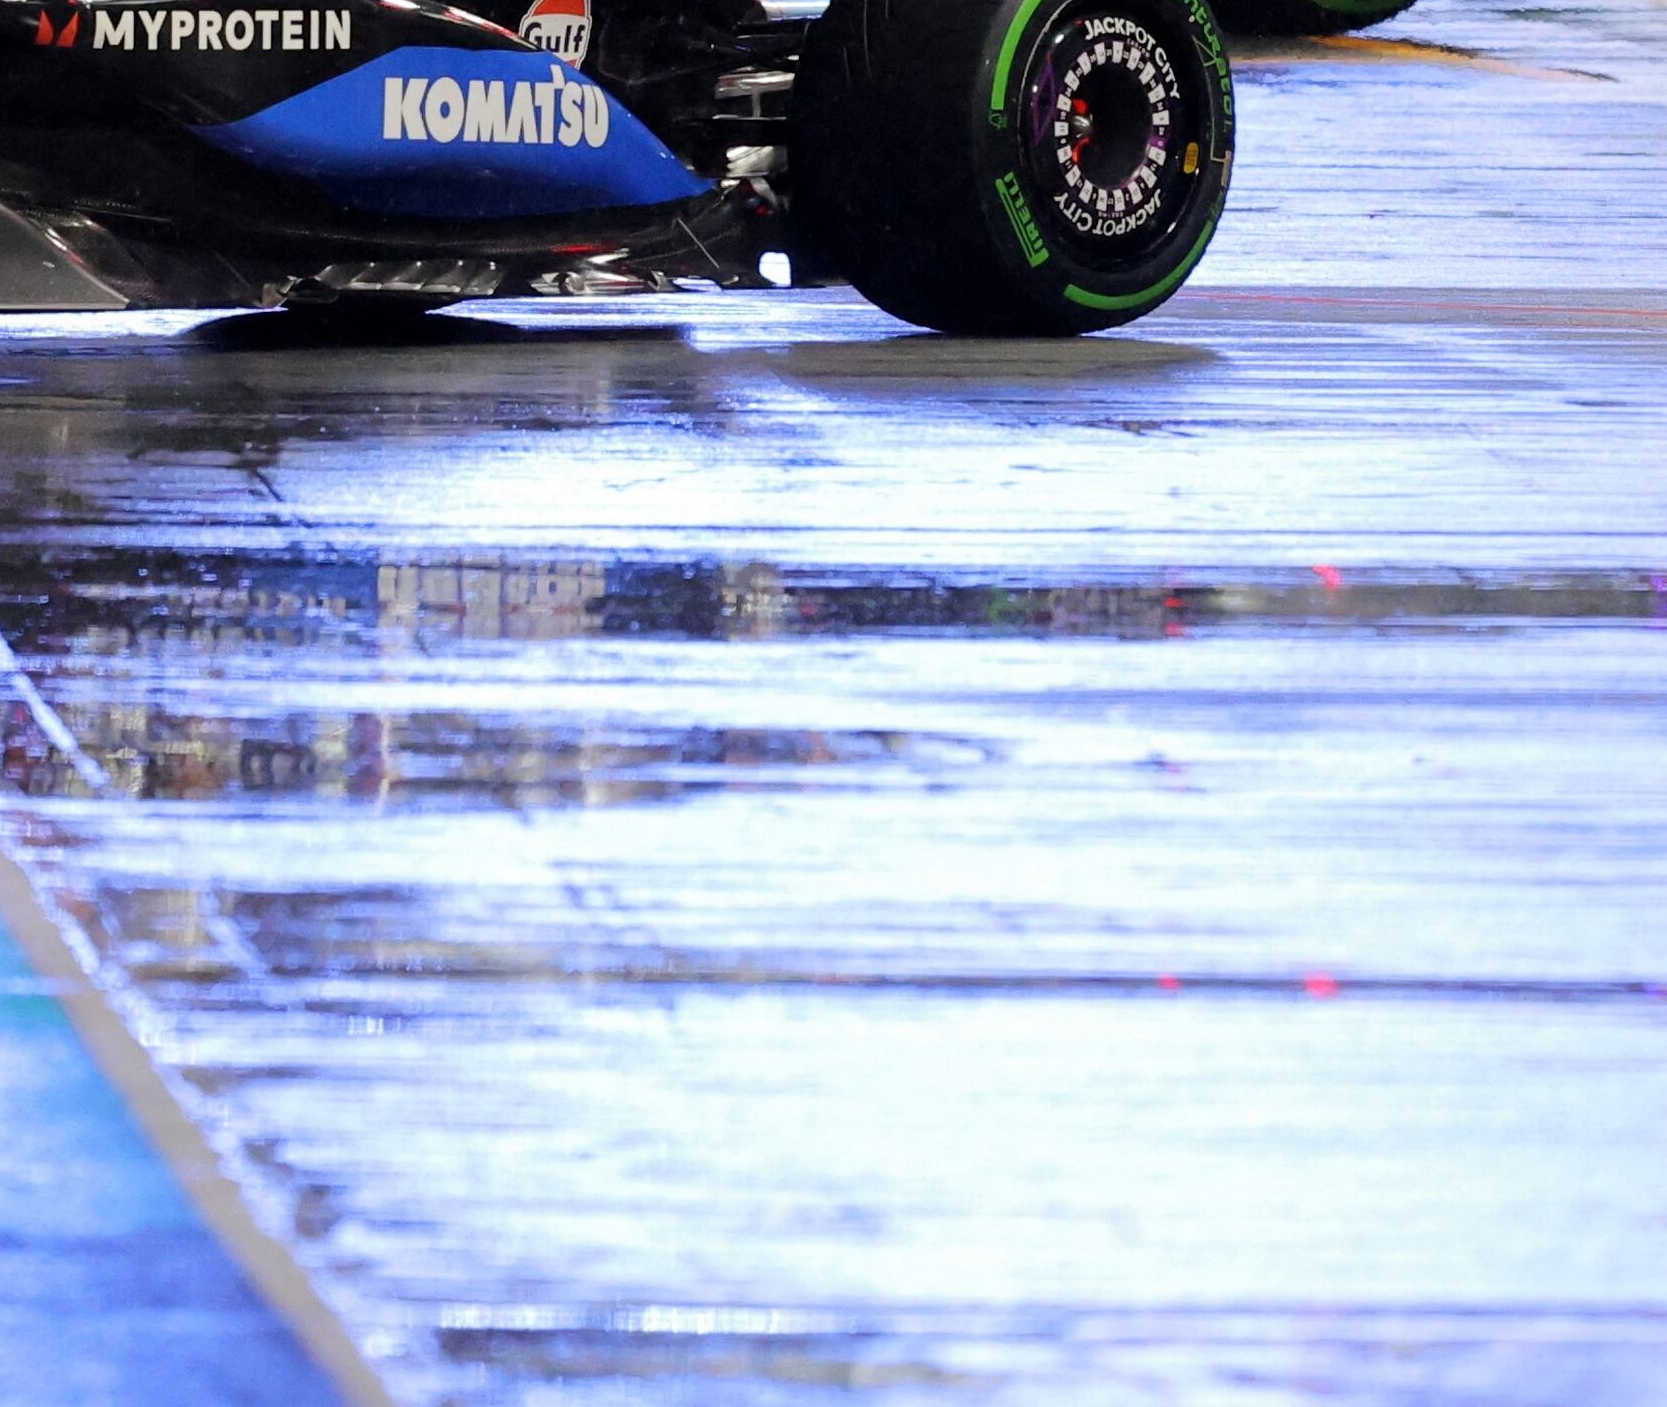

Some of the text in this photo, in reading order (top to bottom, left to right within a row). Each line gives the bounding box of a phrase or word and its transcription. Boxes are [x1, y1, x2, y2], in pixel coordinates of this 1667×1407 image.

[92, 9, 351, 51] MYPROTEIN
[523, 21, 586, 54] Gulf
[1085, 16, 1180, 99] JACKPOT CITY
[383, 64, 609, 148] KOMATSU
[995, 171, 1050, 269] PIRELLI
[1053, 189, 1162, 236] JACKPOT CITY
